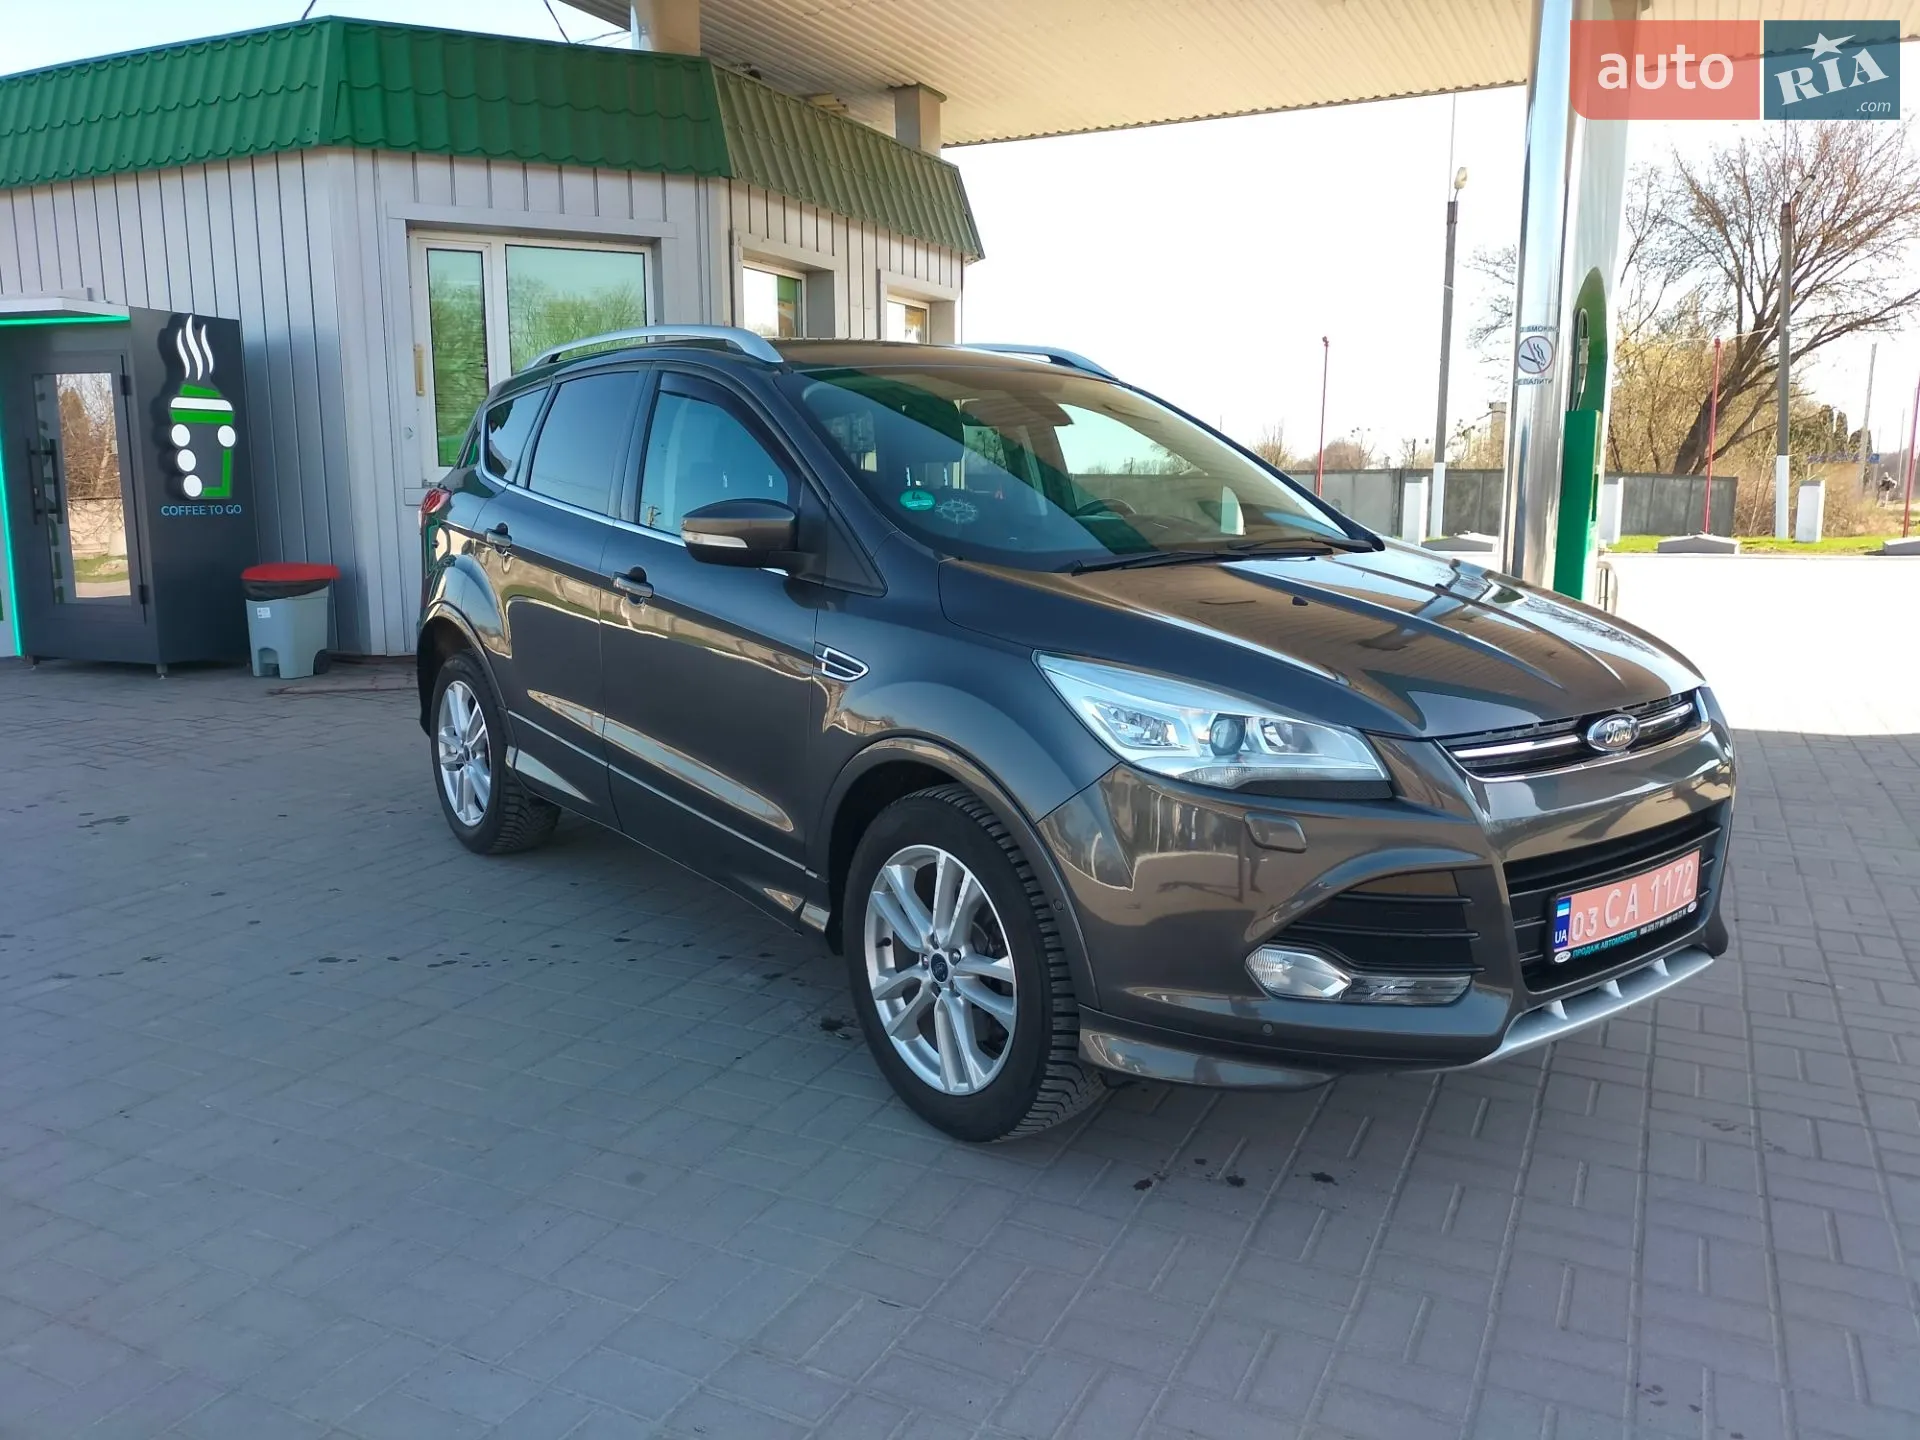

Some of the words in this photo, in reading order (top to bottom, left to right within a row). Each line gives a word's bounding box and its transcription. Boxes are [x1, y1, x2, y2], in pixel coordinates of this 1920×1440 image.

[161, 505, 207, 517] COFFEE
[208, 505, 223, 515] TO
[225, 504, 242, 515] GO
[1571, 906, 1599, 942] 03
[1651, 860, 1694, 913] 1172
[1554, 930, 1567, 944] UA
